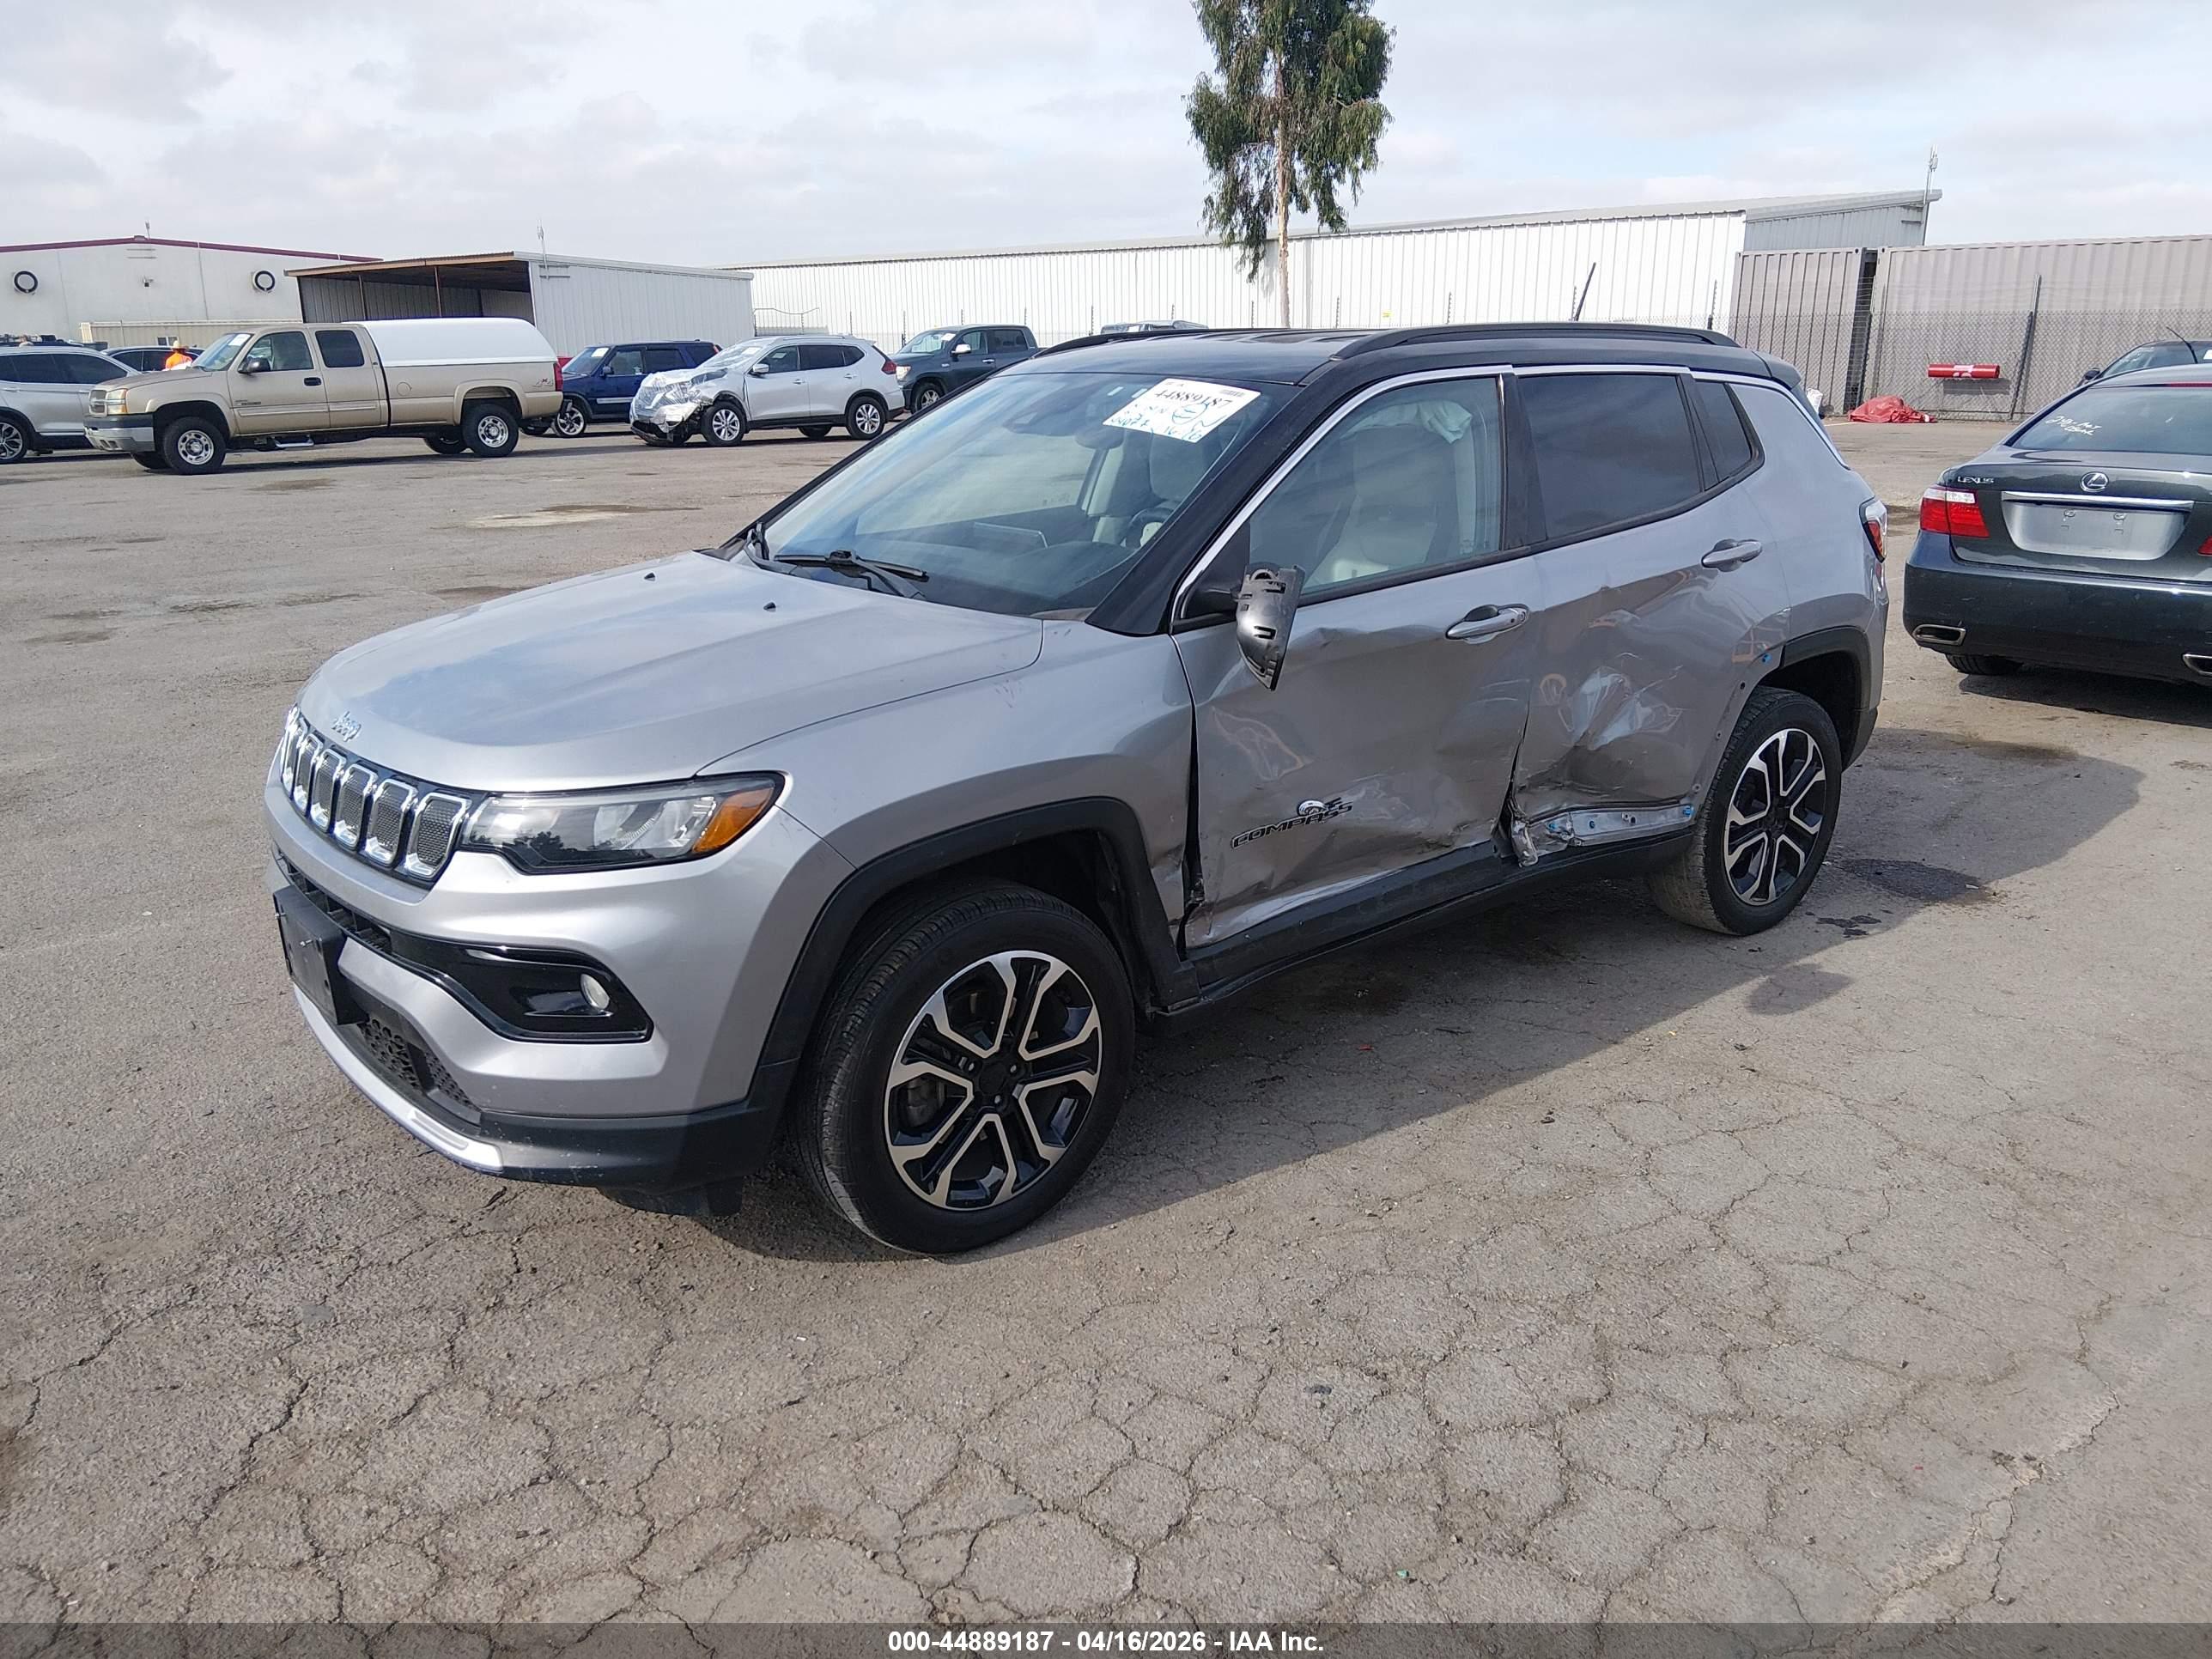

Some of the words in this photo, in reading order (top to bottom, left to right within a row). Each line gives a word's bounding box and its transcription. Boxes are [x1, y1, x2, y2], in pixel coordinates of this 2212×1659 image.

[1155, 389, 1233, 407] 44889187
[1957, 476, 1995, 485] LEXUS
[330, 710, 362, 743] Jeep
[1231, 801, 1353, 849] COMPASS
